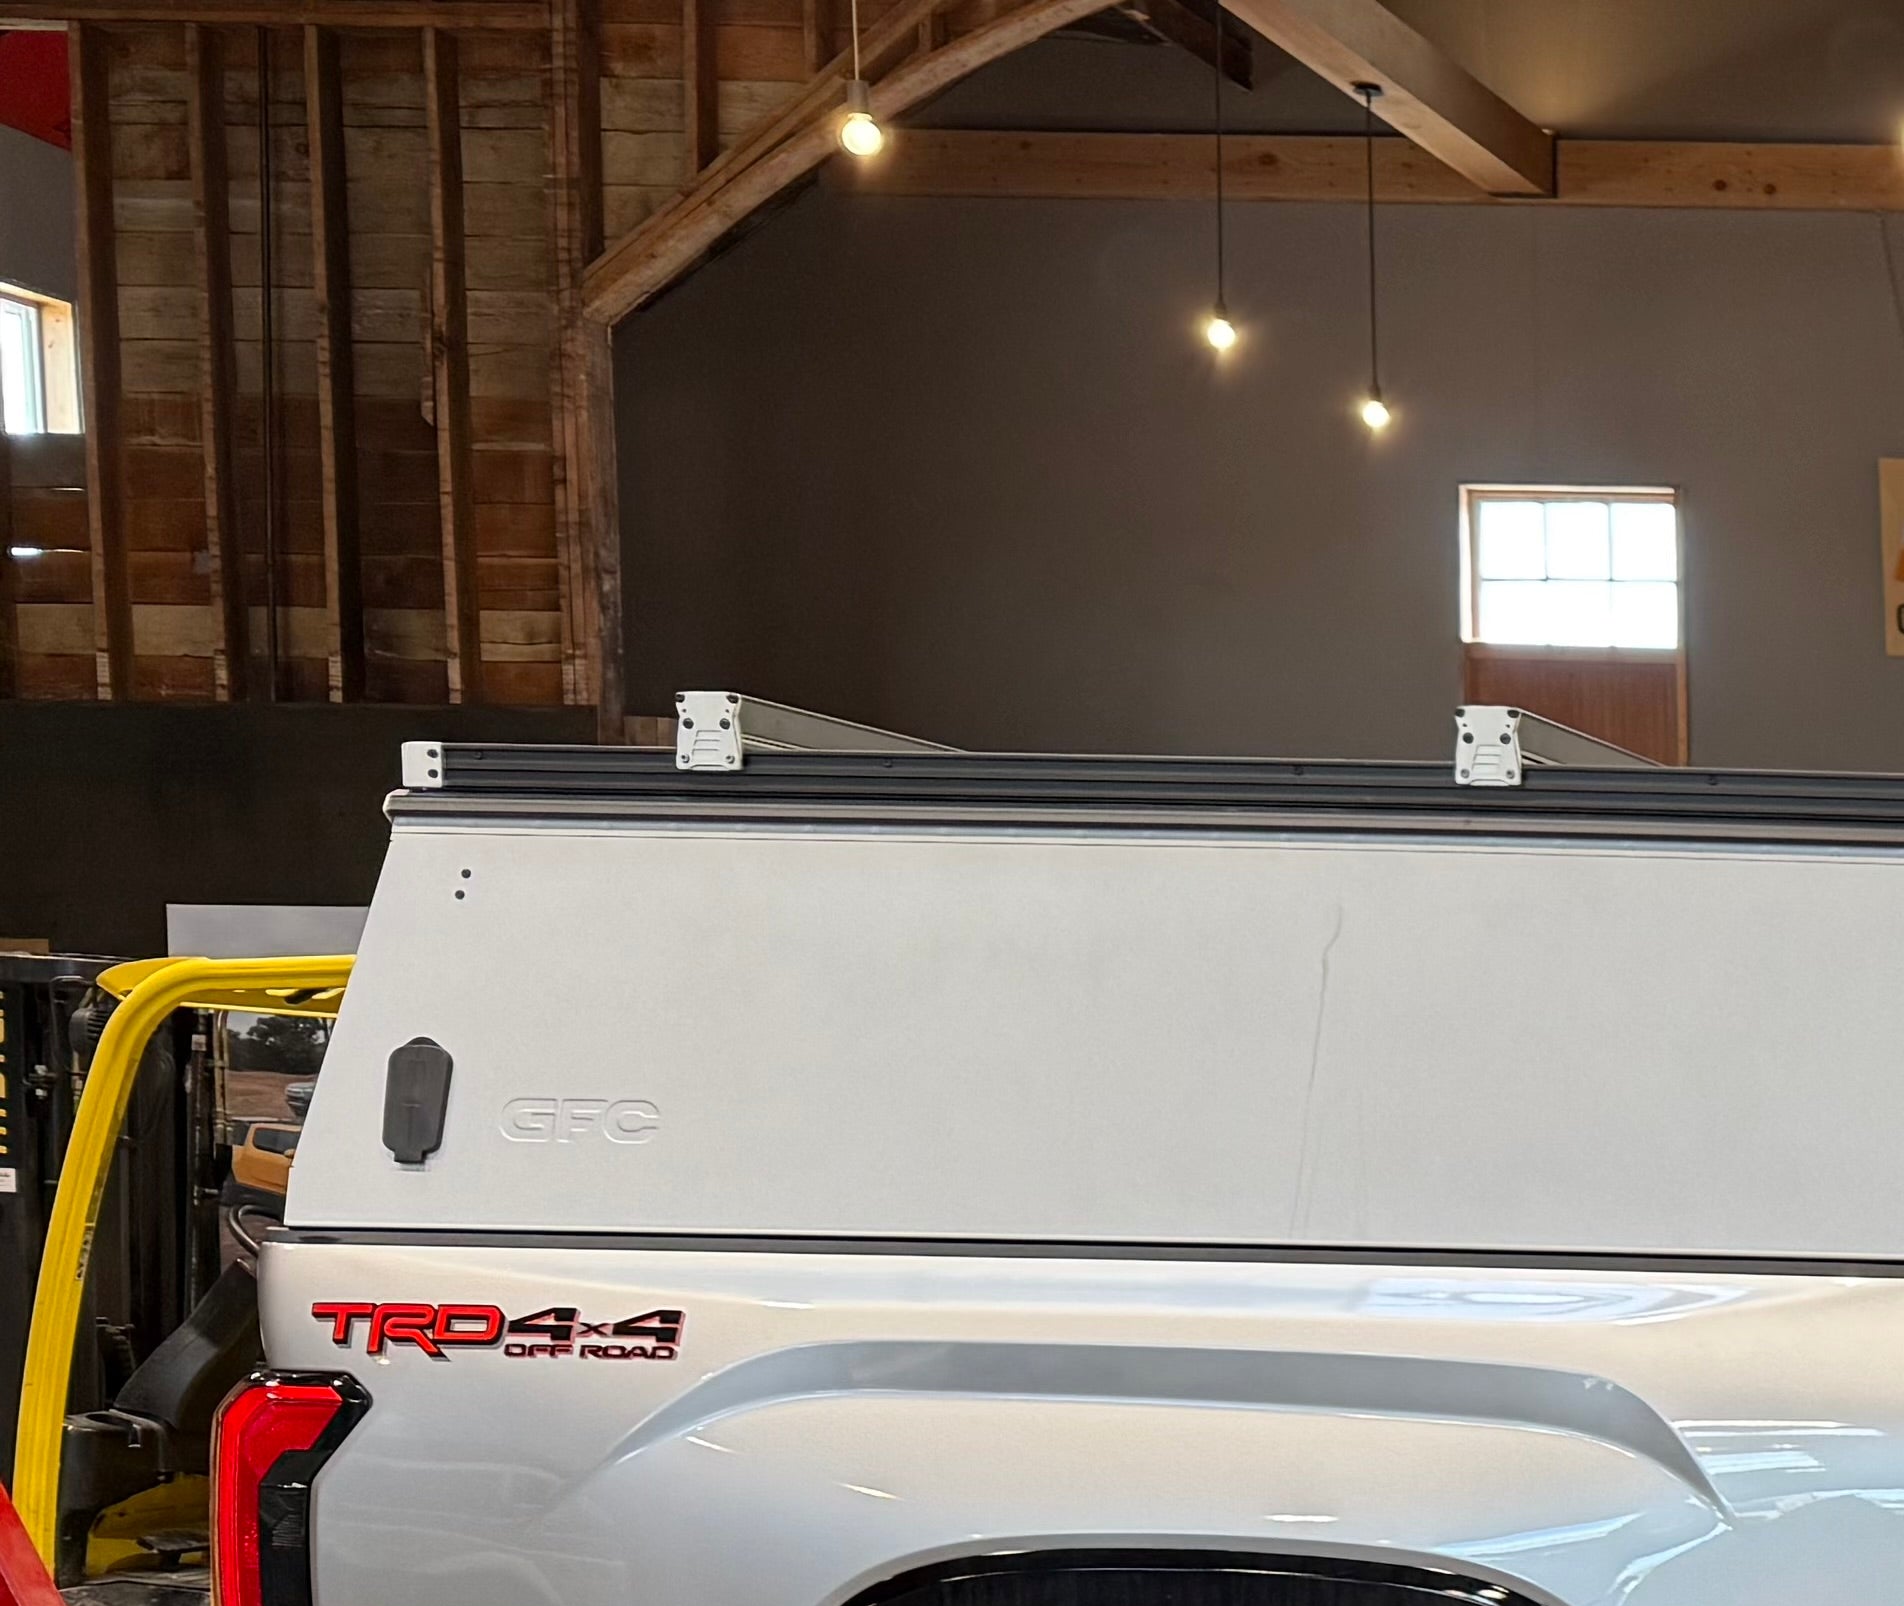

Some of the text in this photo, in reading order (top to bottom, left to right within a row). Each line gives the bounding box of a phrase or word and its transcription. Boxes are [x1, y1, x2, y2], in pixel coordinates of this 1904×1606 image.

[499, 1097, 661, 1144] GFC
[311, 1302, 506, 1362] TRD
[503, 1343, 680, 1361] OFF ROAD
